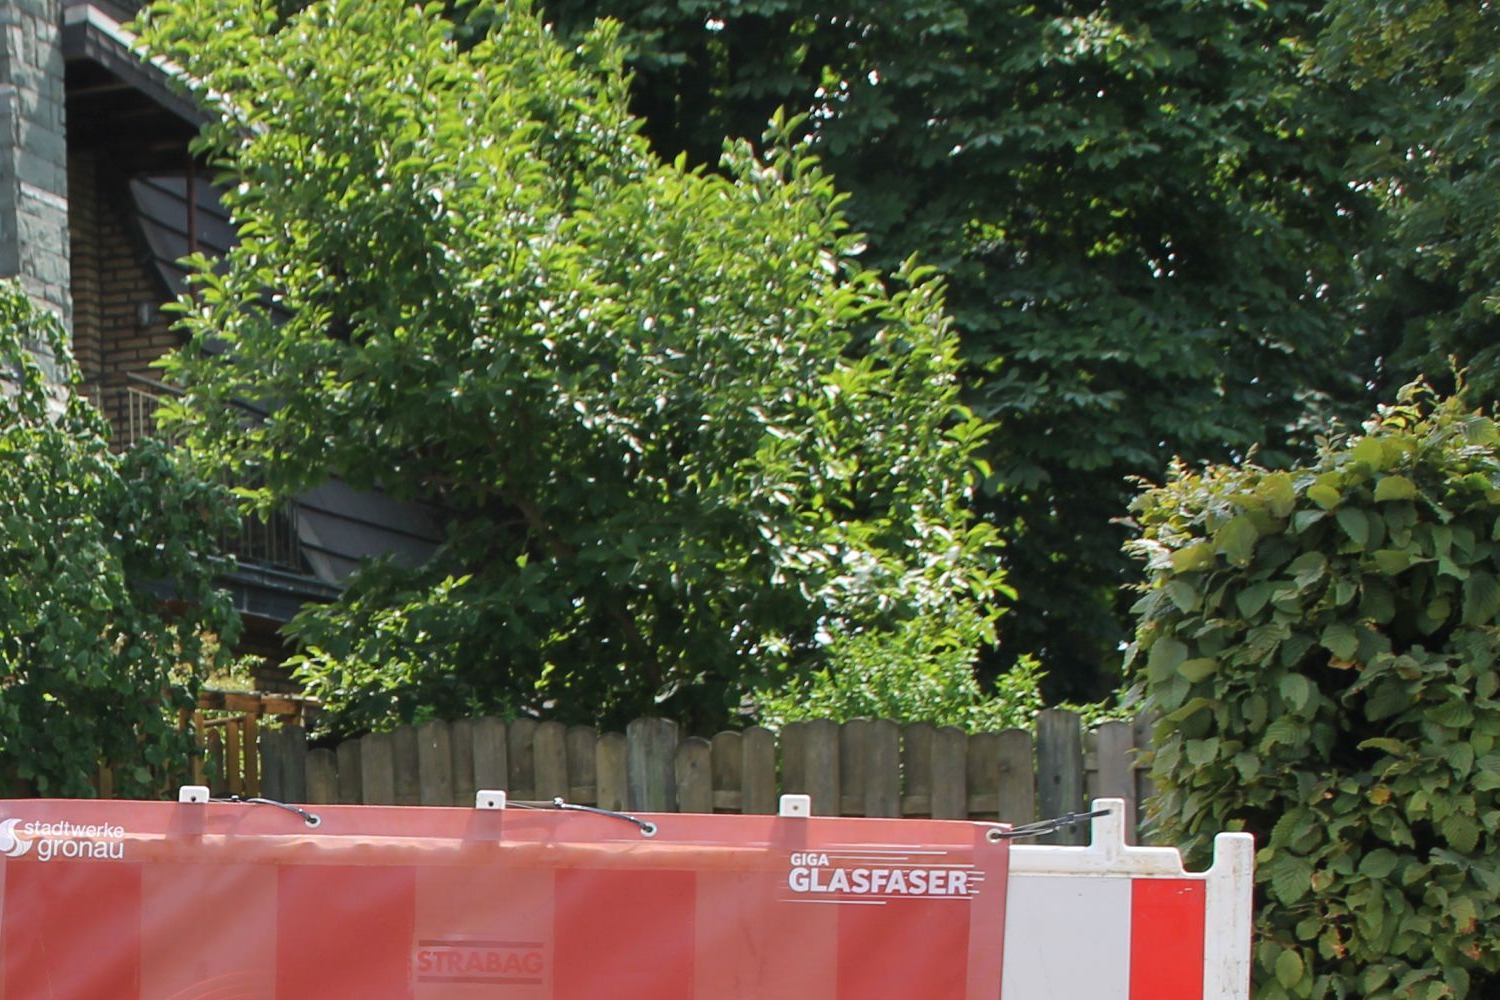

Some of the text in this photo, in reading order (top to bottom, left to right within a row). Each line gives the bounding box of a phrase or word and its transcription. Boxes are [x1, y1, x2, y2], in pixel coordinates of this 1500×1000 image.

[24, 820, 125, 839] stadtwerke
[37, 838, 125, 862] gronau
[790, 852, 830, 867] GIGA
[788, 867, 969, 895] GLASFASER
[416, 950, 544, 974] STRABAG
